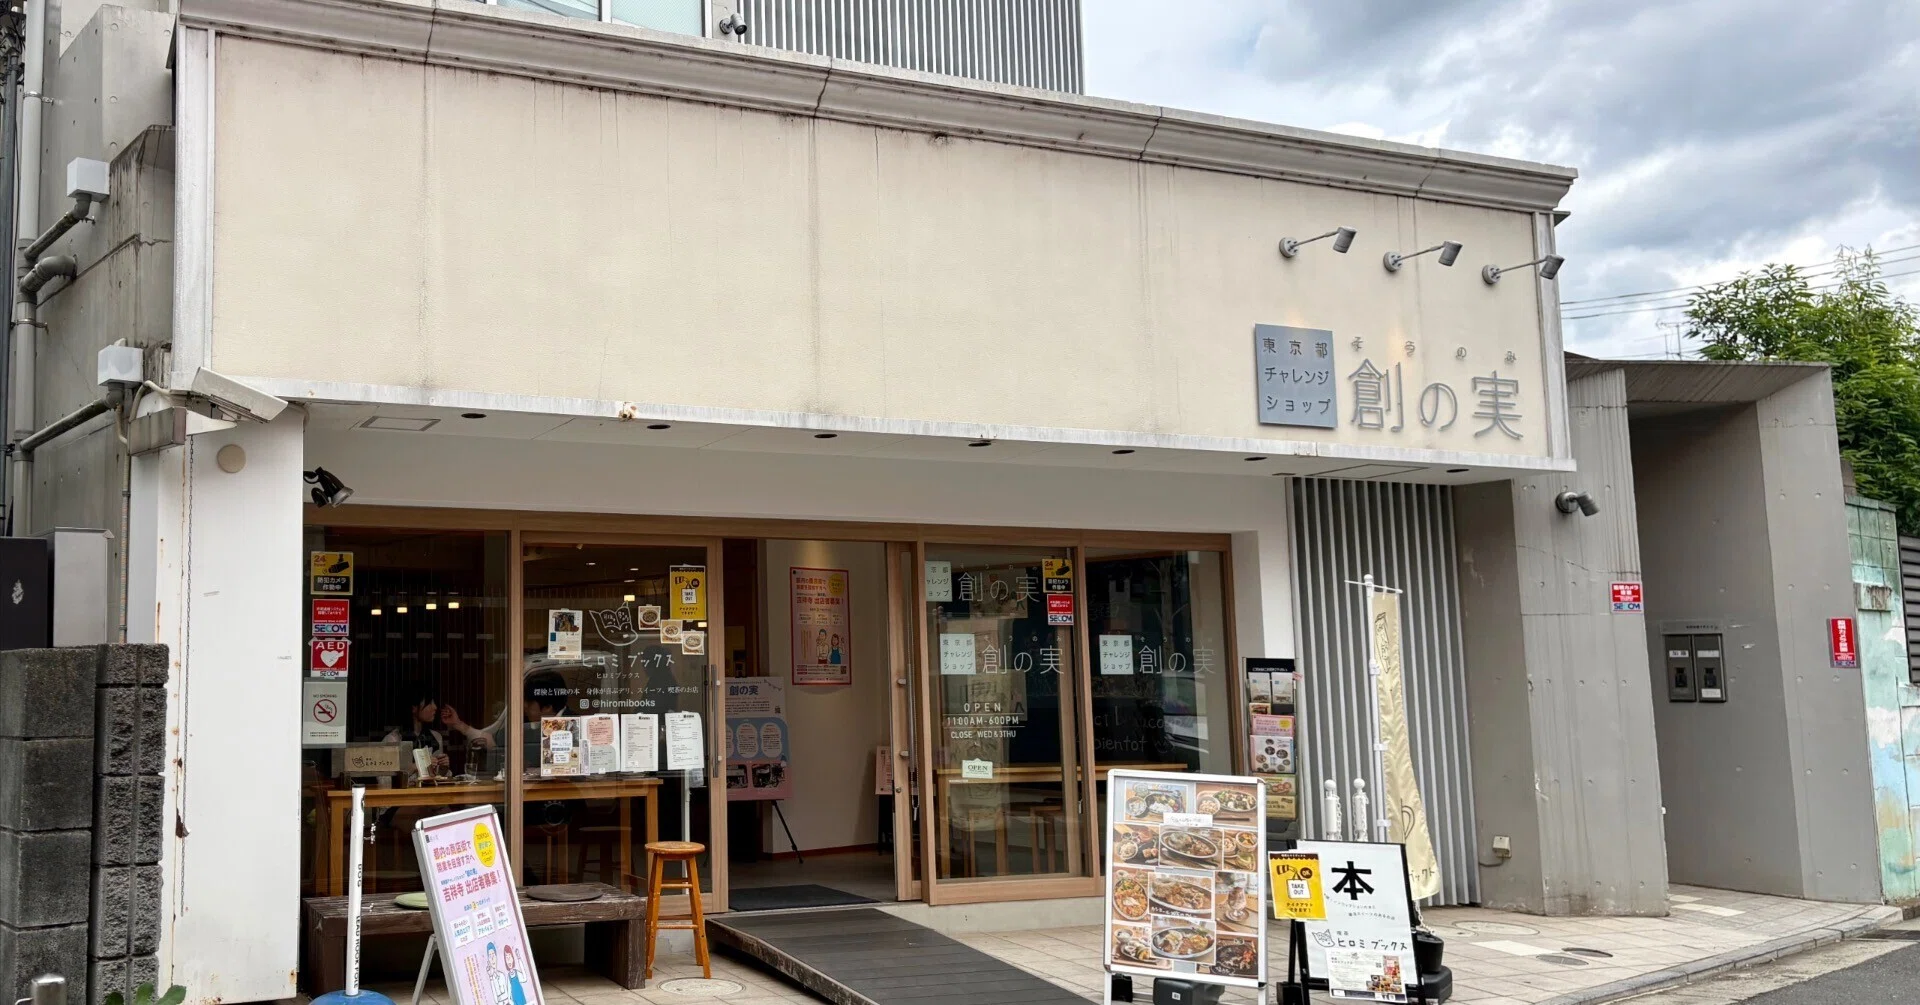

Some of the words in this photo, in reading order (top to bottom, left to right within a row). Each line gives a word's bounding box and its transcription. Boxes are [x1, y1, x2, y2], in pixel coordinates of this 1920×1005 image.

[1262, 337, 1329, 359] 東京都
[1264, 366, 1330, 385] チャレンジ
[1347, 357, 1524, 440] 創の実
[1266, 395, 1332, 415] ショップ
[958, 572, 1040, 602] 創の実
[314, 624, 347, 633] SECOM
[315, 641, 346, 650] AED
[981, 644, 1065, 675] 創の実
[1102, 651, 1131, 659] チャレンジ
[1138, 645, 1217, 676] 創の実
[943, 662, 973, 670] ショップ
[1102, 662, 1131, 670] ショップ
[596, 671, 640, 679] ヒロミブックス
[729, 685, 759, 696] 創の実
[592, 698, 656, 708] @hiromibooks
[963, 702, 1002, 713] OPEN
[950, 730, 973, 739] CLOSE
[1302, 869, 1311, 877] OK
[1331, 860, 1375, 900] 本
